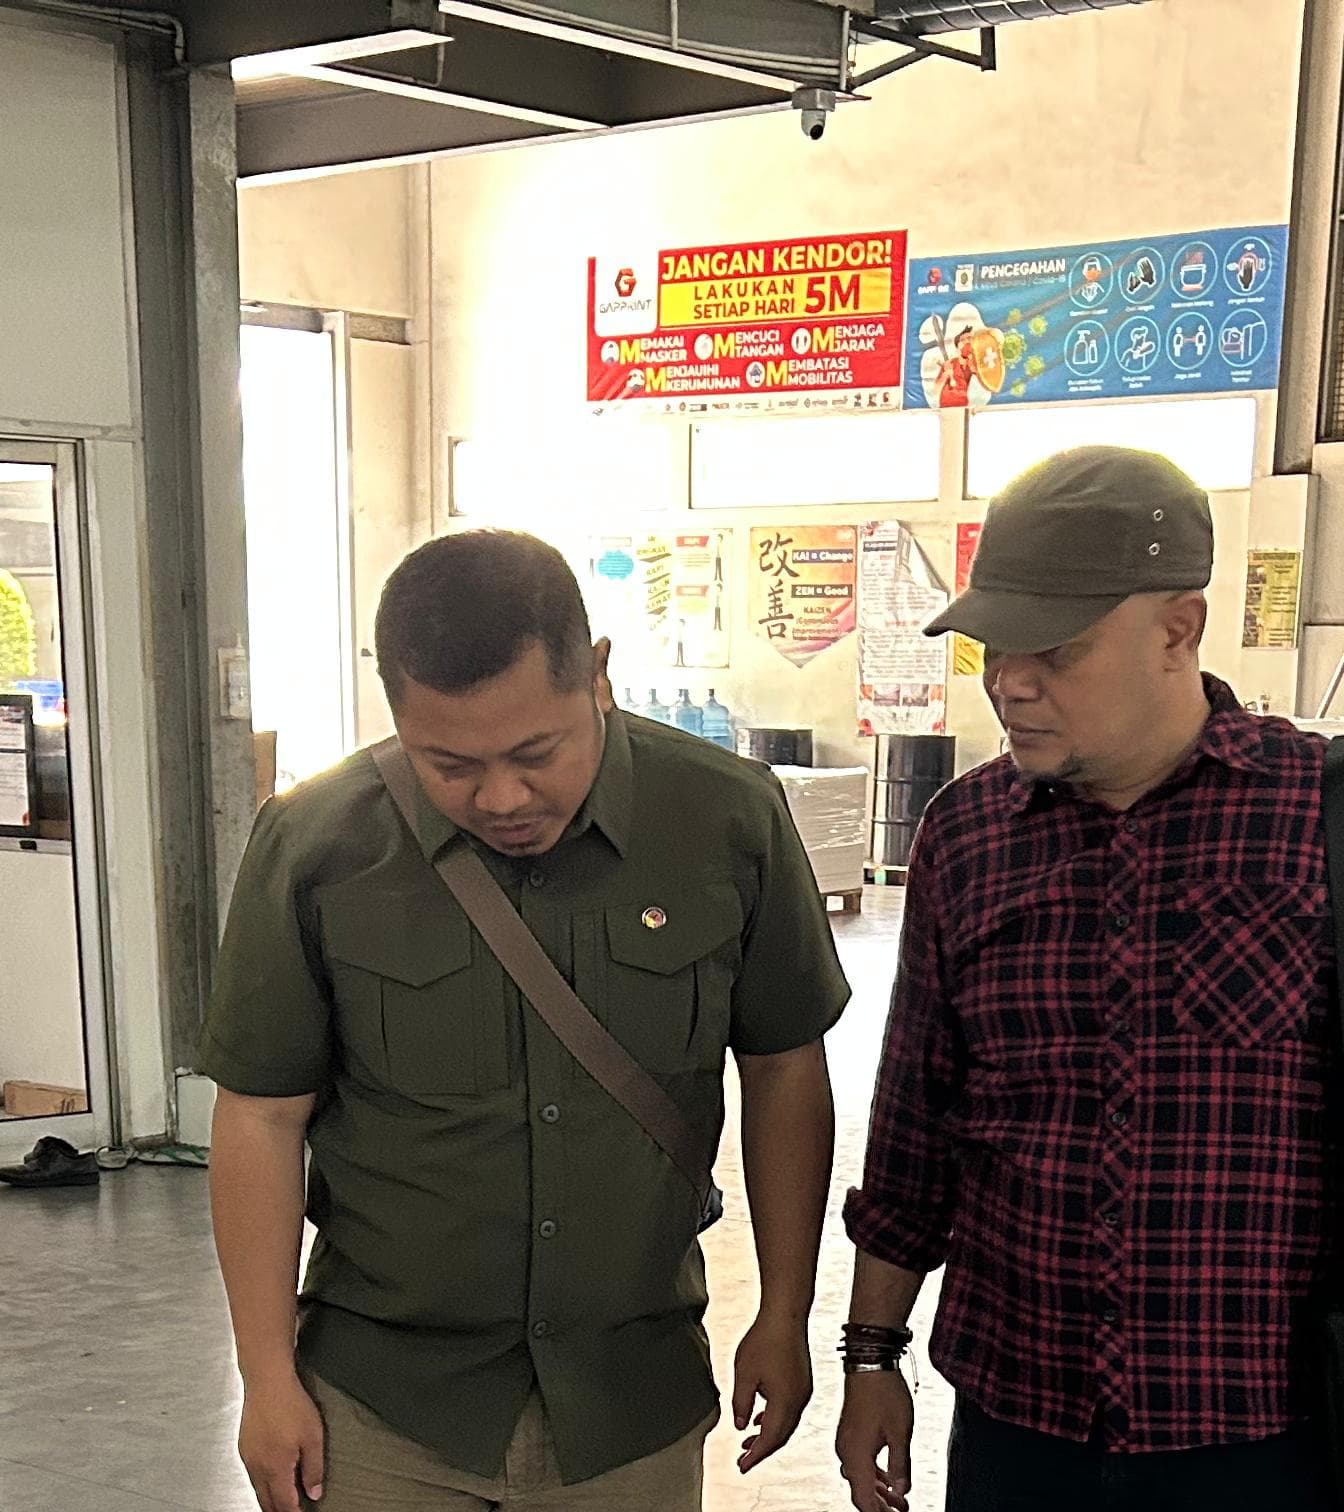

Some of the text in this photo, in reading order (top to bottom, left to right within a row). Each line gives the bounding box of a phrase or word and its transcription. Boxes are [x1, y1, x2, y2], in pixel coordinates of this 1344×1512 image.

[662, 239, 893, 281] JANGAN KENDOR!
[981, 258, 1066, 280] PENCEGAHAN
[695, 279, 795, 301] LAKUKAN
[804, 273, 862, 315] 5M
[693, 298, 795, 320] SETIAP HARI
[734, 343, 784, 357] TANGAN
[787, 370, 853, 386] MOBILITAS
[795, 587, 815, 597] ZEN
